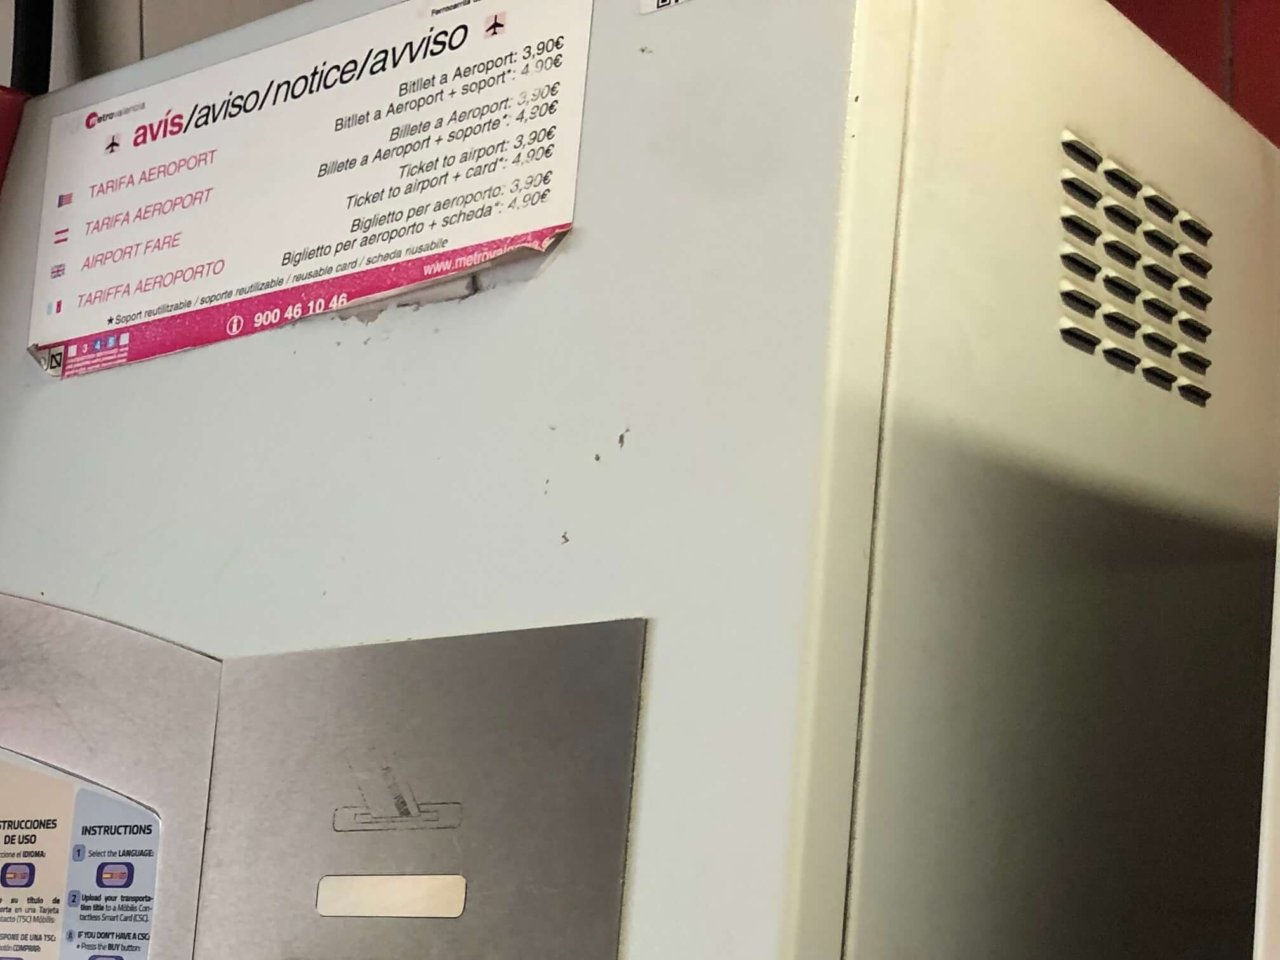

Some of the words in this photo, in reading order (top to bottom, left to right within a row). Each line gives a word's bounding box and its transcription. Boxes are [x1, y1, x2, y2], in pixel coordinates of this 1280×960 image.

[398, 74, 435, 98] Bitllet
[439, 73, 448, 85] a
[452, 51, 517, 82] Aeroport:
[522, 35, 564, 60] 3,90€
[334, 110, 370, 132] Bitllet
[373, 109, 381, 121] a
[386, 90, 444, 118] Aeroport
[449, 88, 457, 99] +
[389, 120, 431, 142] Billete
[434, 117, 443, 130] a
[317, 157, 357, 179] Billete
[360, 154, 369, 167] a
[372, 135, 431, 163] Aeroport
[435, 135, 444, 145] +
[399, 157, 439, 180] Ticket
[442, 154, 456, 169] to
[459, 139, 509, 164] airport:
[514, 125, 557, 149] 3,90€
[89, 173, 135, 199] TARIFA
[138, 149, 218, 187] AEROPORT
[346, 187, 385, 210] Ticket
[388, 185, 401, 199] to
[403, 171, 448, 195] airport
[452, 171, 460, 182] +
[85, 211, 130, 236] TARIFA
[133, 188, 213, 223] AEROPORT
[350, 209, 403, 234] Biglietto
[405, 202, 431, 223] per
[81, 243, 141, 272] AIRPORT
[143, 231, 182, 255] FARE
[281, 243, 331, 268] Biglietto
[334, 238, 357, 258] per
[359, 221, 424, 249] aeroporto
[428, 220, 437, 231] +
[77, 282, 130, 309] TARIFFA
[133, 258, 225, 299] AEROPORTO
[199, 289, 233, 308] soporte
[235, 275, 283, 299] reutilizable
[292, 264, 333, 284] reusable
[335, 257, 358, 275] card
[366, 248, 402, 266] scheda
[253, 308, 280, 328] 900
[284, 303, 302, 320] 46
[307, 298, 325, 316] 10
[328, 292, 348, 311] 46
[3, 834, 17, 846] DE
[17, 834, 37, 846] USO
[81, 824, 153, 836] INSTRUCTIONS
[87, 849, 106, 858] Select
[107, 849, 118, 858] the
[81, 893, 102, 903] Upload
[84, 931, 97, 940] YOU
[115, 932, 132, 941] HAVE
[120, 914, 133, 922] Card
[81, 942, 97, 951] Press
[107, 943, 120, 952] BUY
